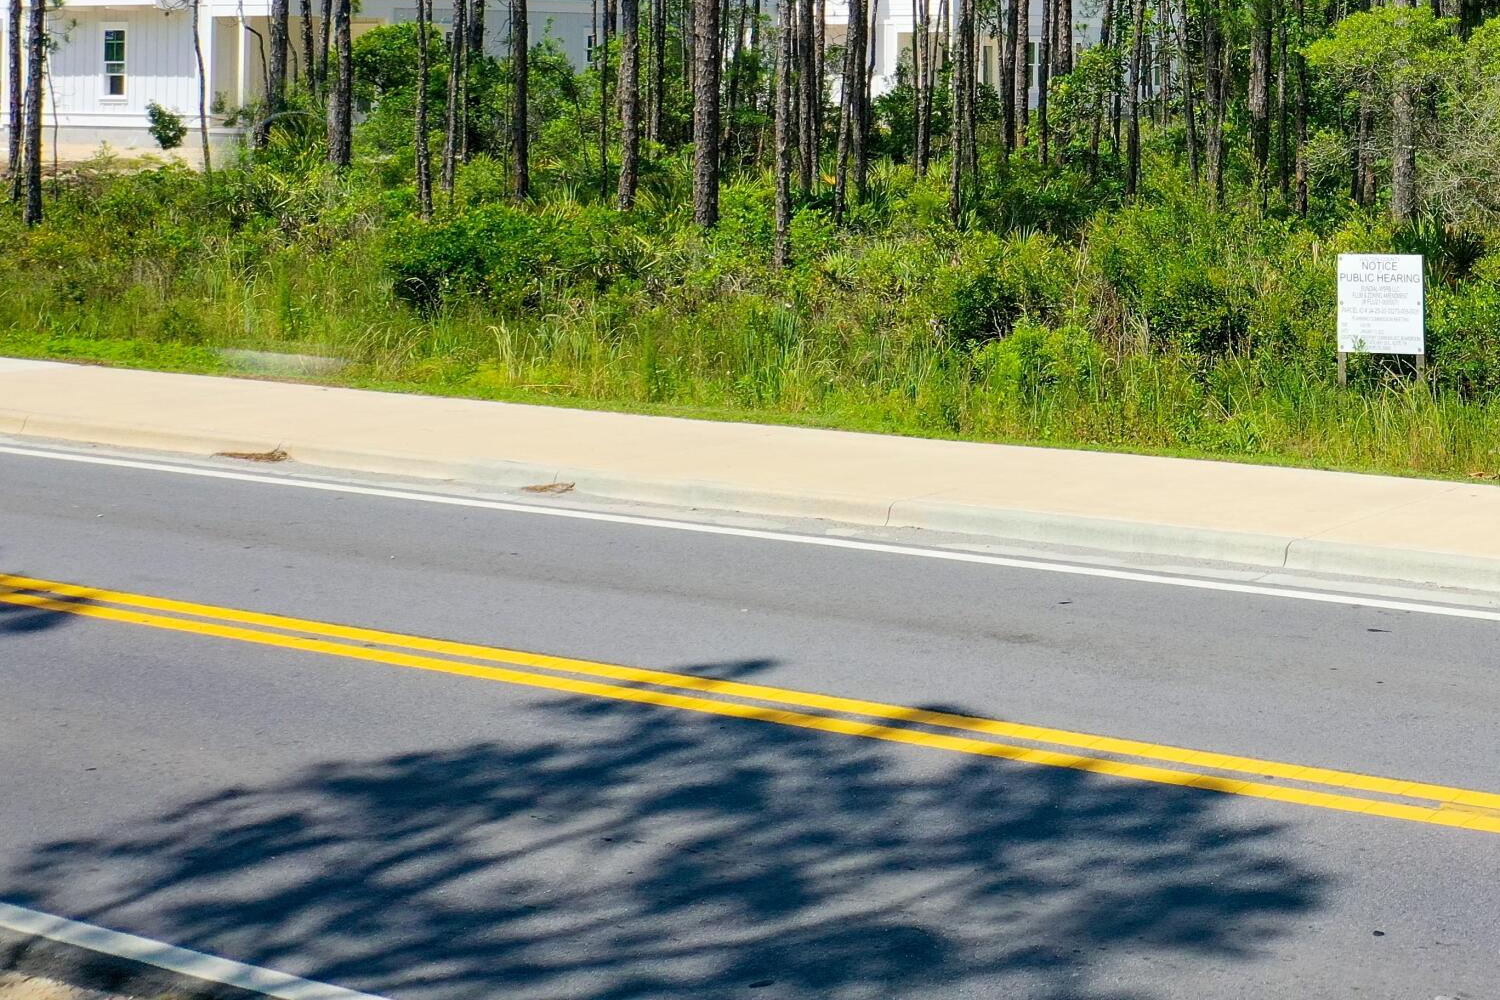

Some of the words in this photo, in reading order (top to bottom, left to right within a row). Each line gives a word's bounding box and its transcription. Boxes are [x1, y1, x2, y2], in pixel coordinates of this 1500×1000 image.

[1361, 261, 1398, 271] NOTICE
[1339, 273, 1375, 283] PUBLIC
[1376, 273, 1421, 283] HEARING
